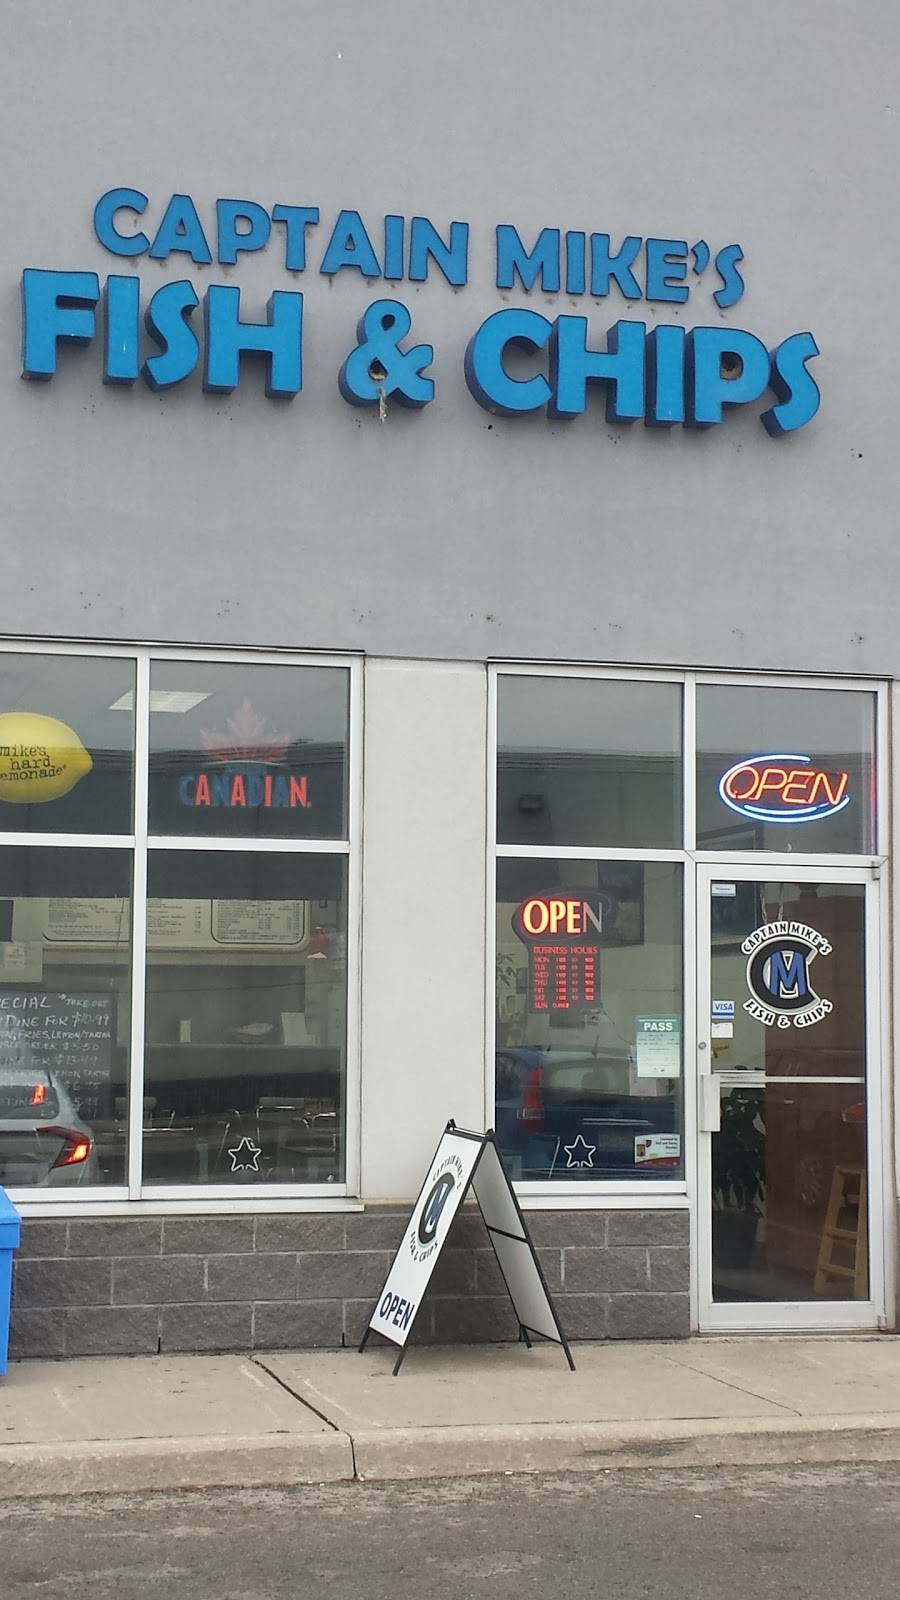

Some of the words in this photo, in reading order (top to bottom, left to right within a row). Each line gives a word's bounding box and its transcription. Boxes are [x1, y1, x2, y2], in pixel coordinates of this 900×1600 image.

[94, 188, 469, 287] CAPTAIN
[496, 225, 745, 307] MIKE'S
[23, 268, 303, 400] FISH
[340, 298, 434, 408] &
[465, 309, 820, 433] CHIPS
[0, 744, 48, 757] mike's
[10, 756, 52, 770] hard
[0, 766, 64, 780] emonade
[726, 766, 848, 805] OPEN
[180, 773, 308, 808] CANADIAN
[523, 900, 602, 933] OPEN
[742, 921, 788, 953] CAPTAIN
[789, 922, 832, 955] MIKE'S
[0, 996, 52, 1009] ECIAL
[714, 1002, 733, 1011] VISA
[743, 999, 775, 1026] FISH
[777, 1014, 791, 1028] &
[794, 999, 832, 1028] CHIPS
[45, 1015, 69, 1026] FOR
[644, 1022, 673, 1031] PASS
[379, 1291, 416, 1331] OPEN
